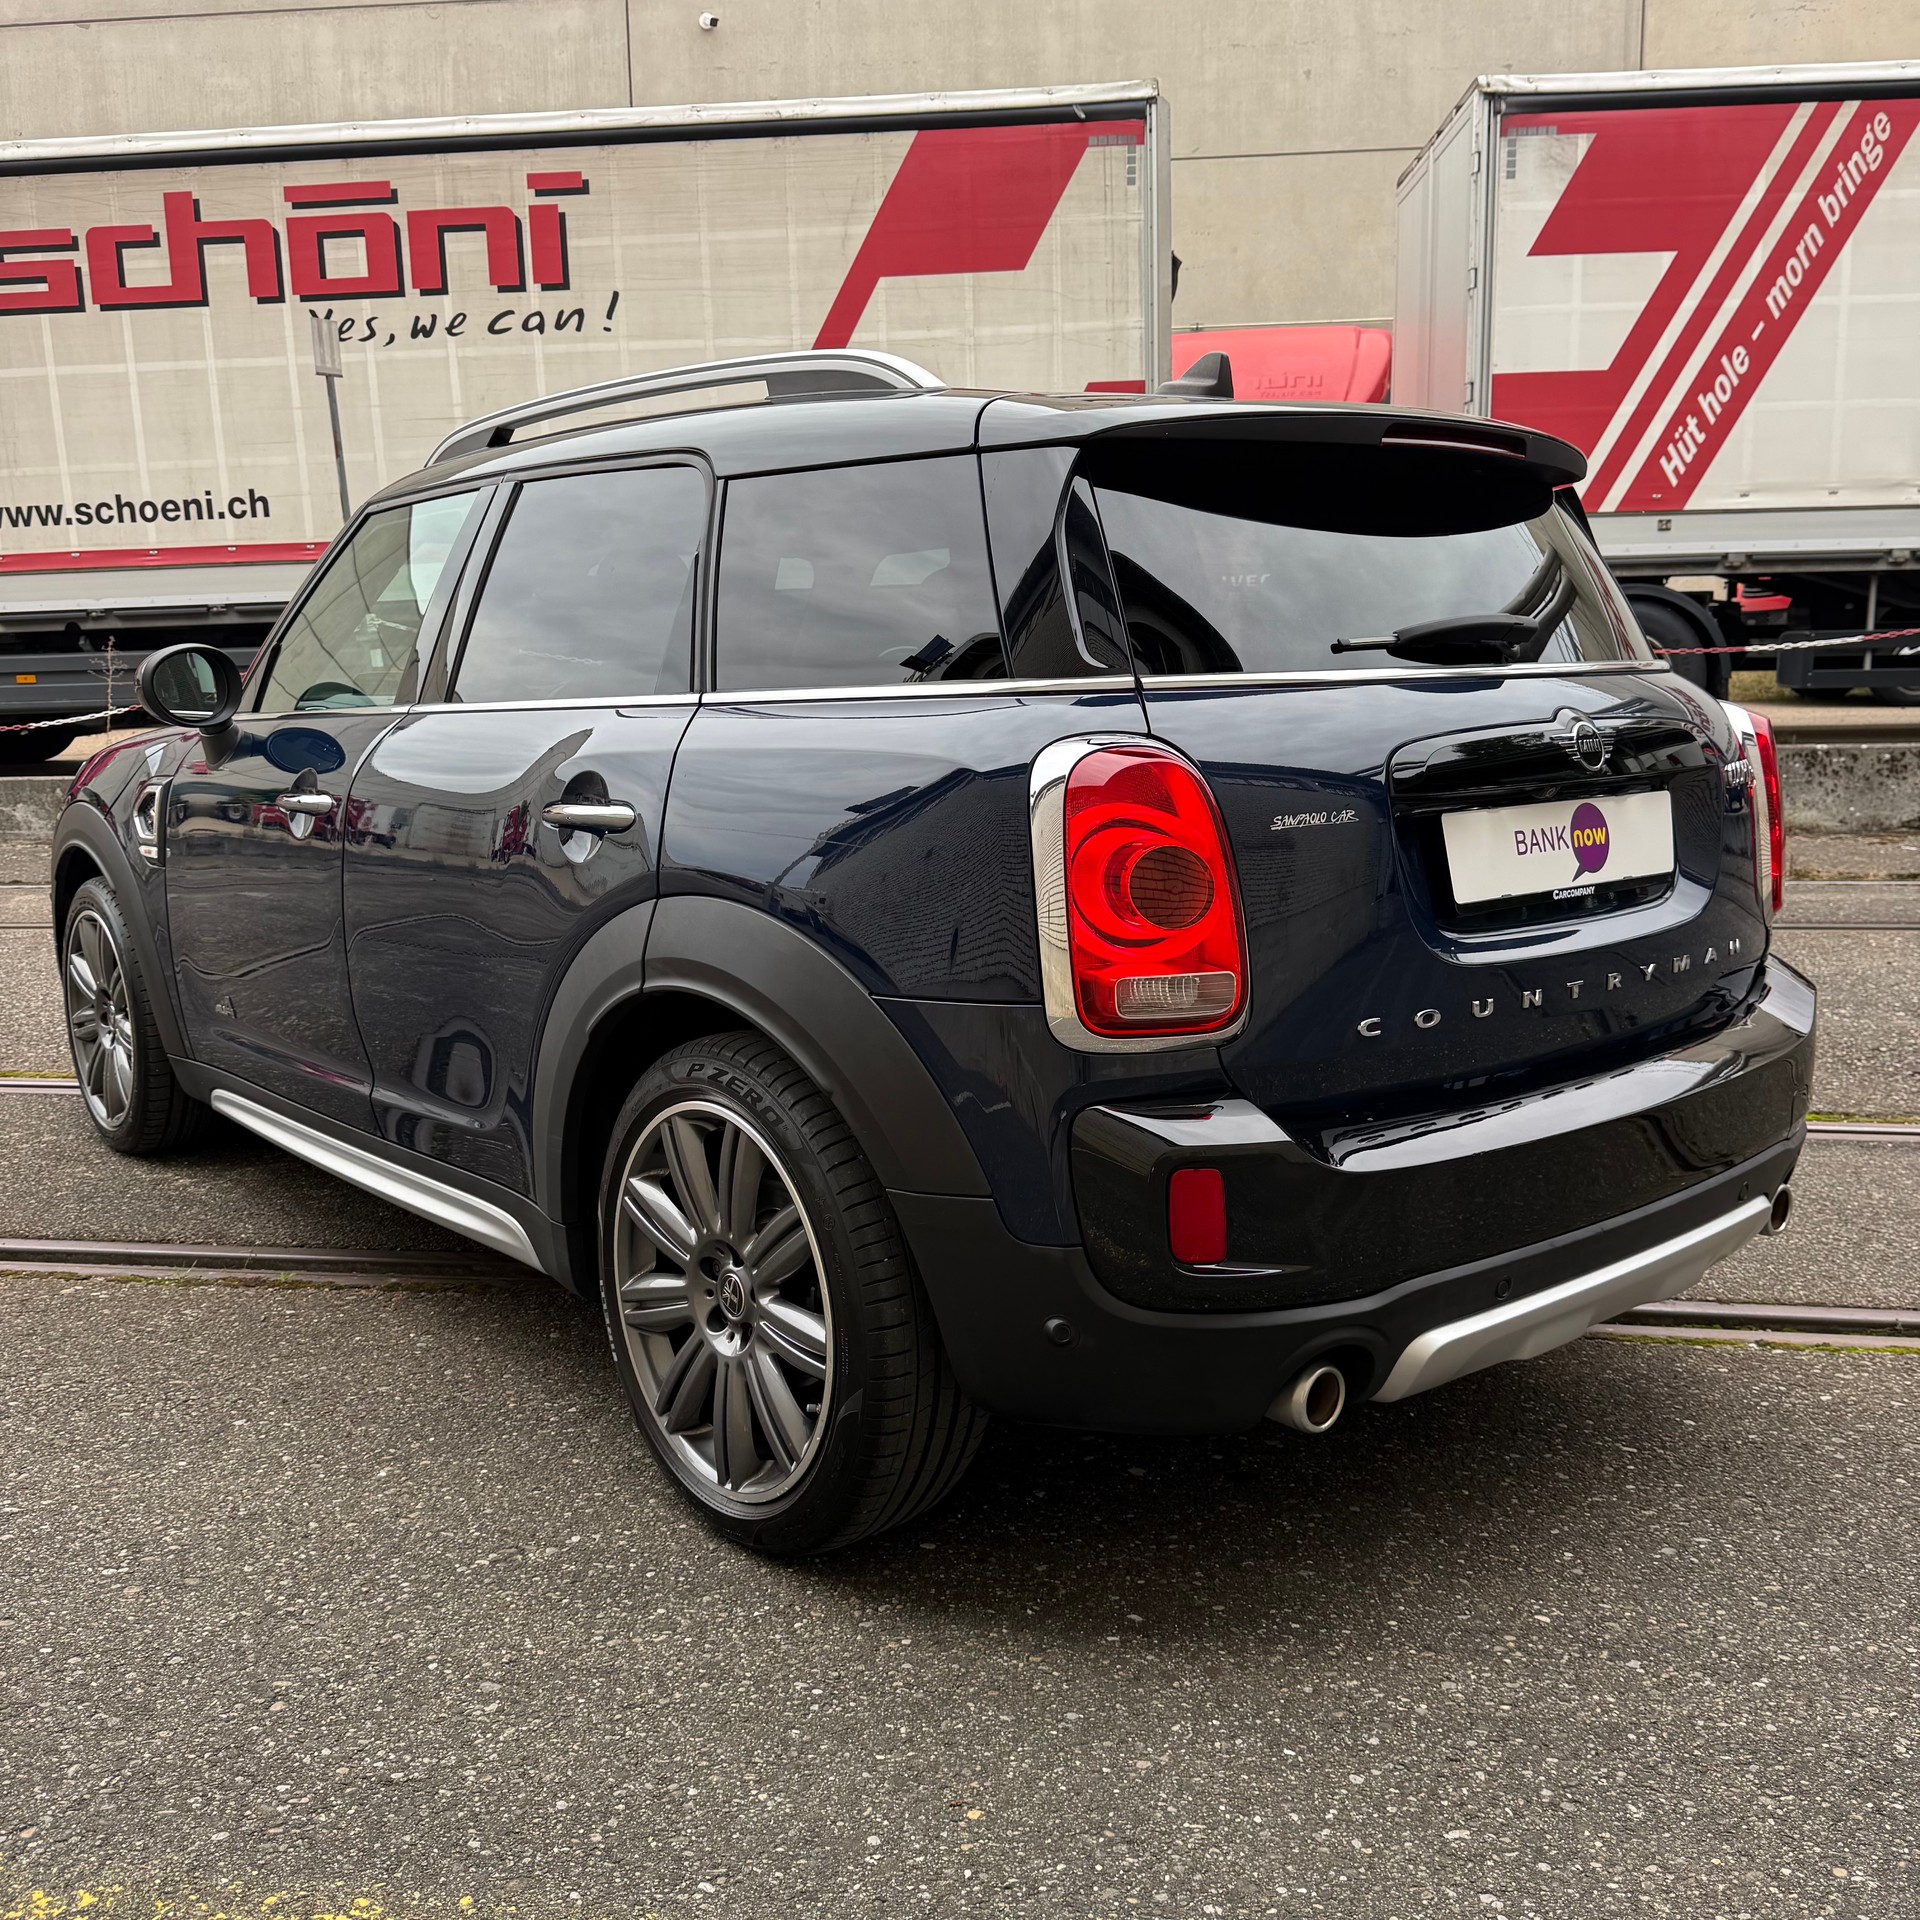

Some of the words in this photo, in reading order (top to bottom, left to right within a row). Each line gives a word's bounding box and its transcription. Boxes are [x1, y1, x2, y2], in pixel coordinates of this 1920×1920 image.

[1658, 414, 1706, 488] Hüt
[1697, 344, 1750, 425] hole
[1765, 222, 1825, 320] morn
[1817, 111, 1892, 228] bringe
[309, 308, 396, 347] es,
[410, 312, 468, 340] we
[0, 489, 271, 528] ww.schoeni.ch
[1330, 809, 1360, 825] CAR
[1514, 825, 1570, 856] BANK
[1573, 827, 1606, 848] now
[707, 1066, 785, 1129] ZERO
